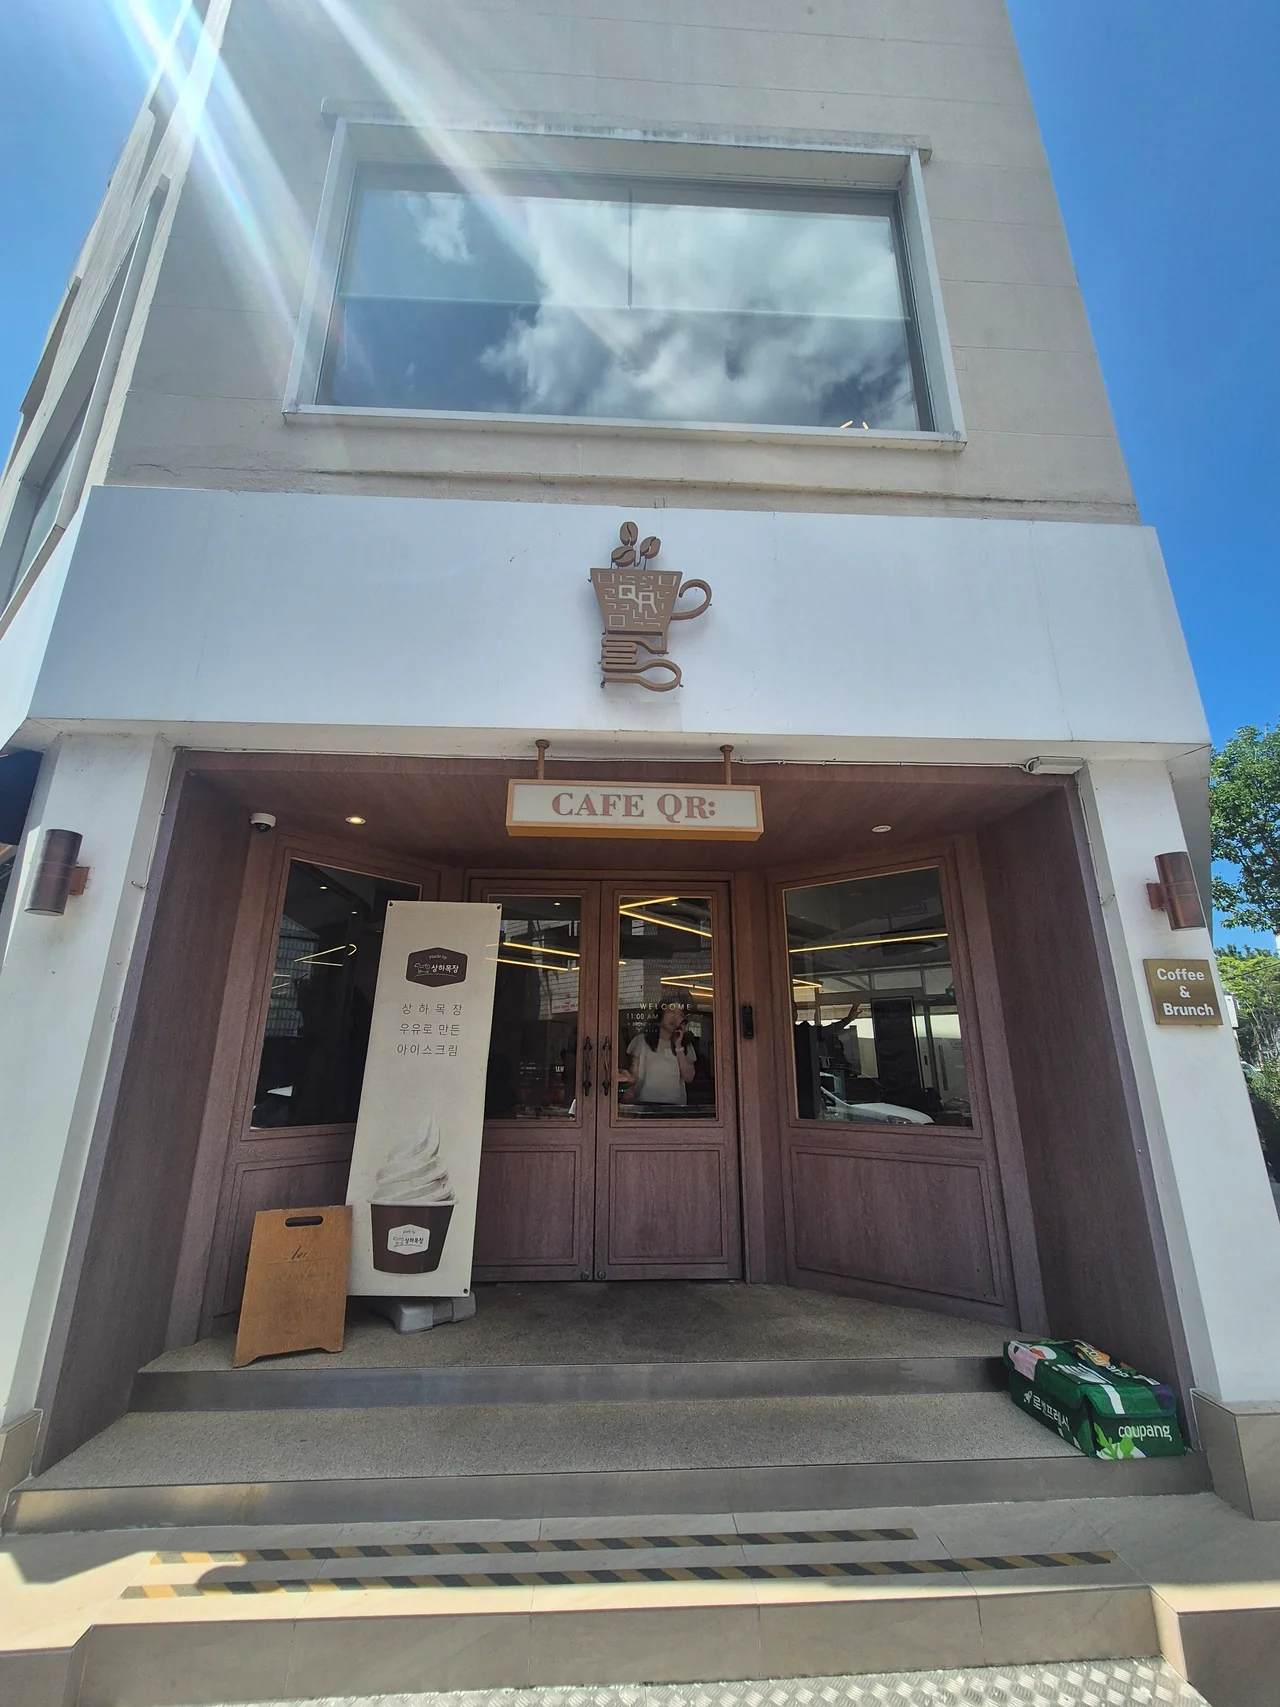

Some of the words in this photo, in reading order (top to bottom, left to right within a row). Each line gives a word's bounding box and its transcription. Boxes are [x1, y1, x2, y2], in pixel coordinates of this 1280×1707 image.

[618, 584, 658, 614] QR
[552, 792, 644, 818] CAFE
[656, 793, 716, 823] QR:
[431, 964, 459, 974] 상하목장
[1156, 968, 1205, 981] Coffee
[1179, 985, 1191, 998] &
[640, 1003, 691, 1011] WELCOME
[1163, 1003, 1215, 1016] Brunch
[400, 1023, 433, 1035] 우유로
[438, 1024, 460, 1036] 만든
[396, 1043, 458, 1057] 아이스크림
[1118, 1424, 1173, 1442] coupang
